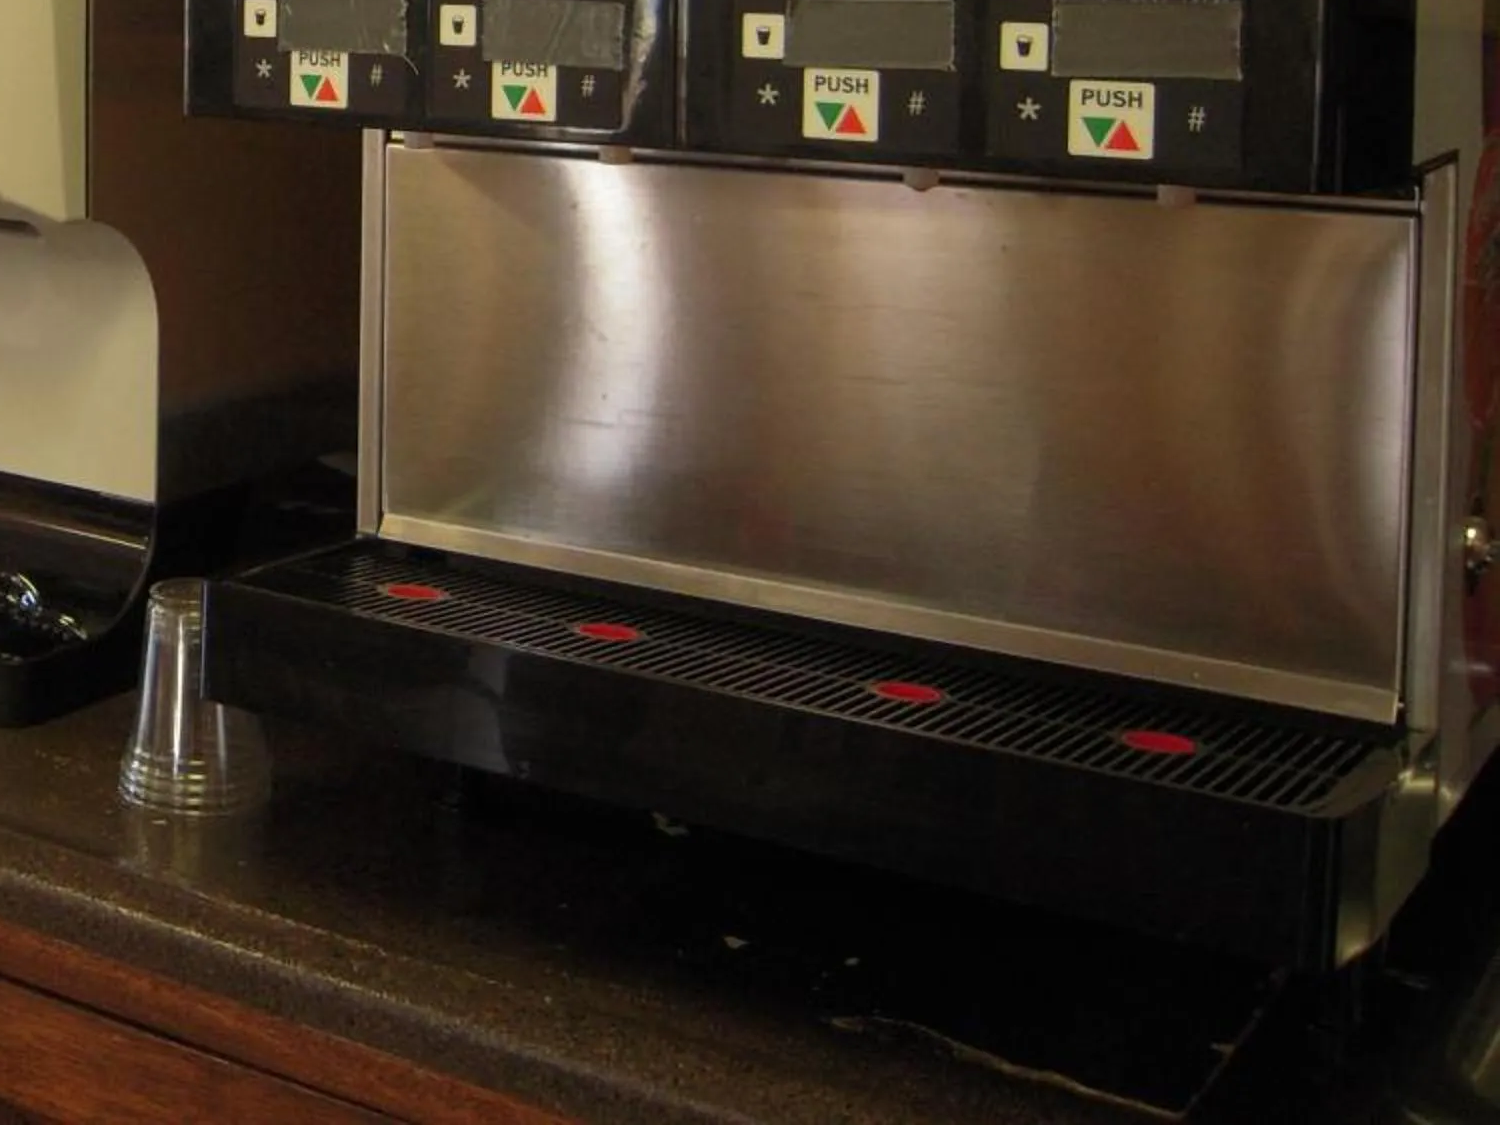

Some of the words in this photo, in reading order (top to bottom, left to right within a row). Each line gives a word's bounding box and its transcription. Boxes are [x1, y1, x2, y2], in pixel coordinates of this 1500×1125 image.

[298, 52, 342, 68] PUSH
[501, 62, 549, 78] PUSH
[813, 76, 870, 95] PUSH
[1080, 89, 1144, 109] PUSH
